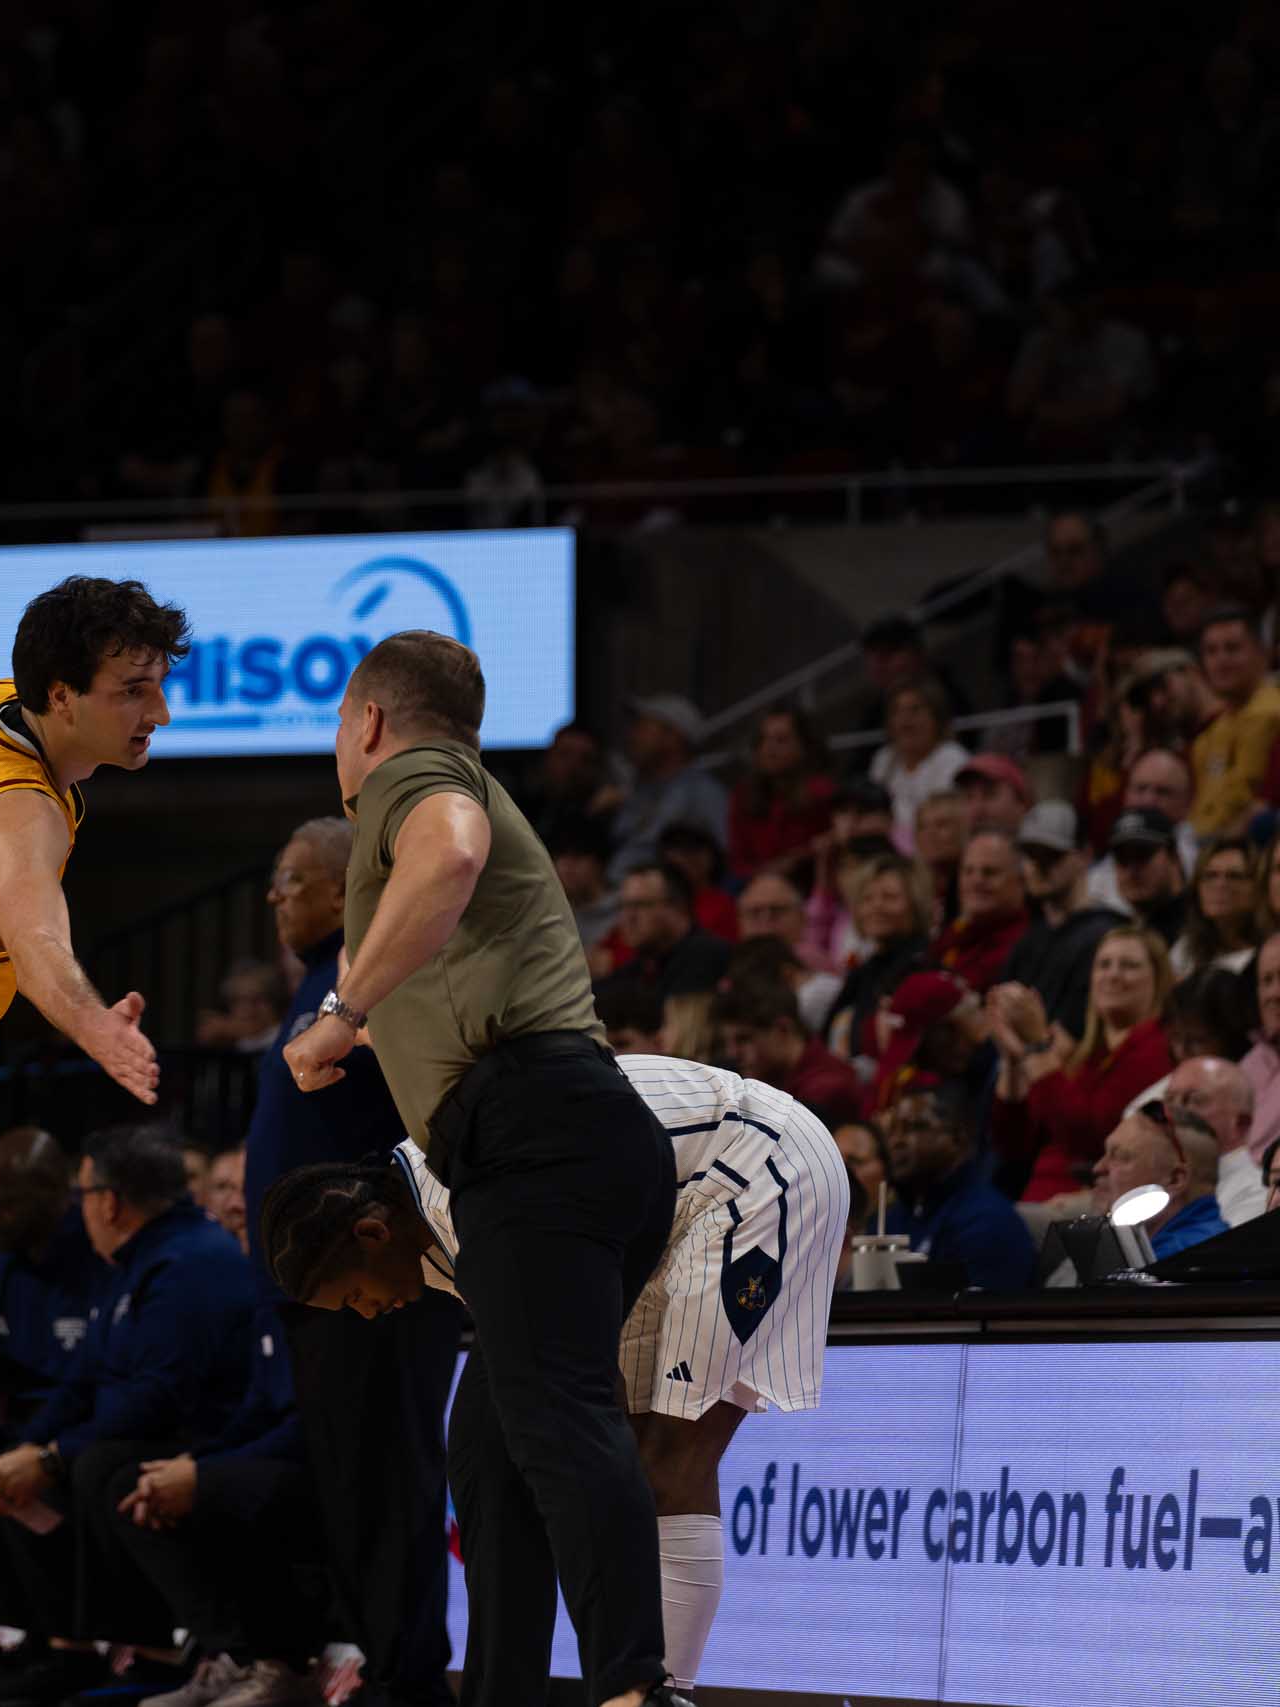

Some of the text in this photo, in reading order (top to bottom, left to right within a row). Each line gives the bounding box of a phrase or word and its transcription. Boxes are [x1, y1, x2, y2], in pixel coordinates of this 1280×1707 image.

[731, 1461, 778, 1557] of
[786, 1462, 910, 1561] lower
[923, 1466, 1087, 1568] carbon
